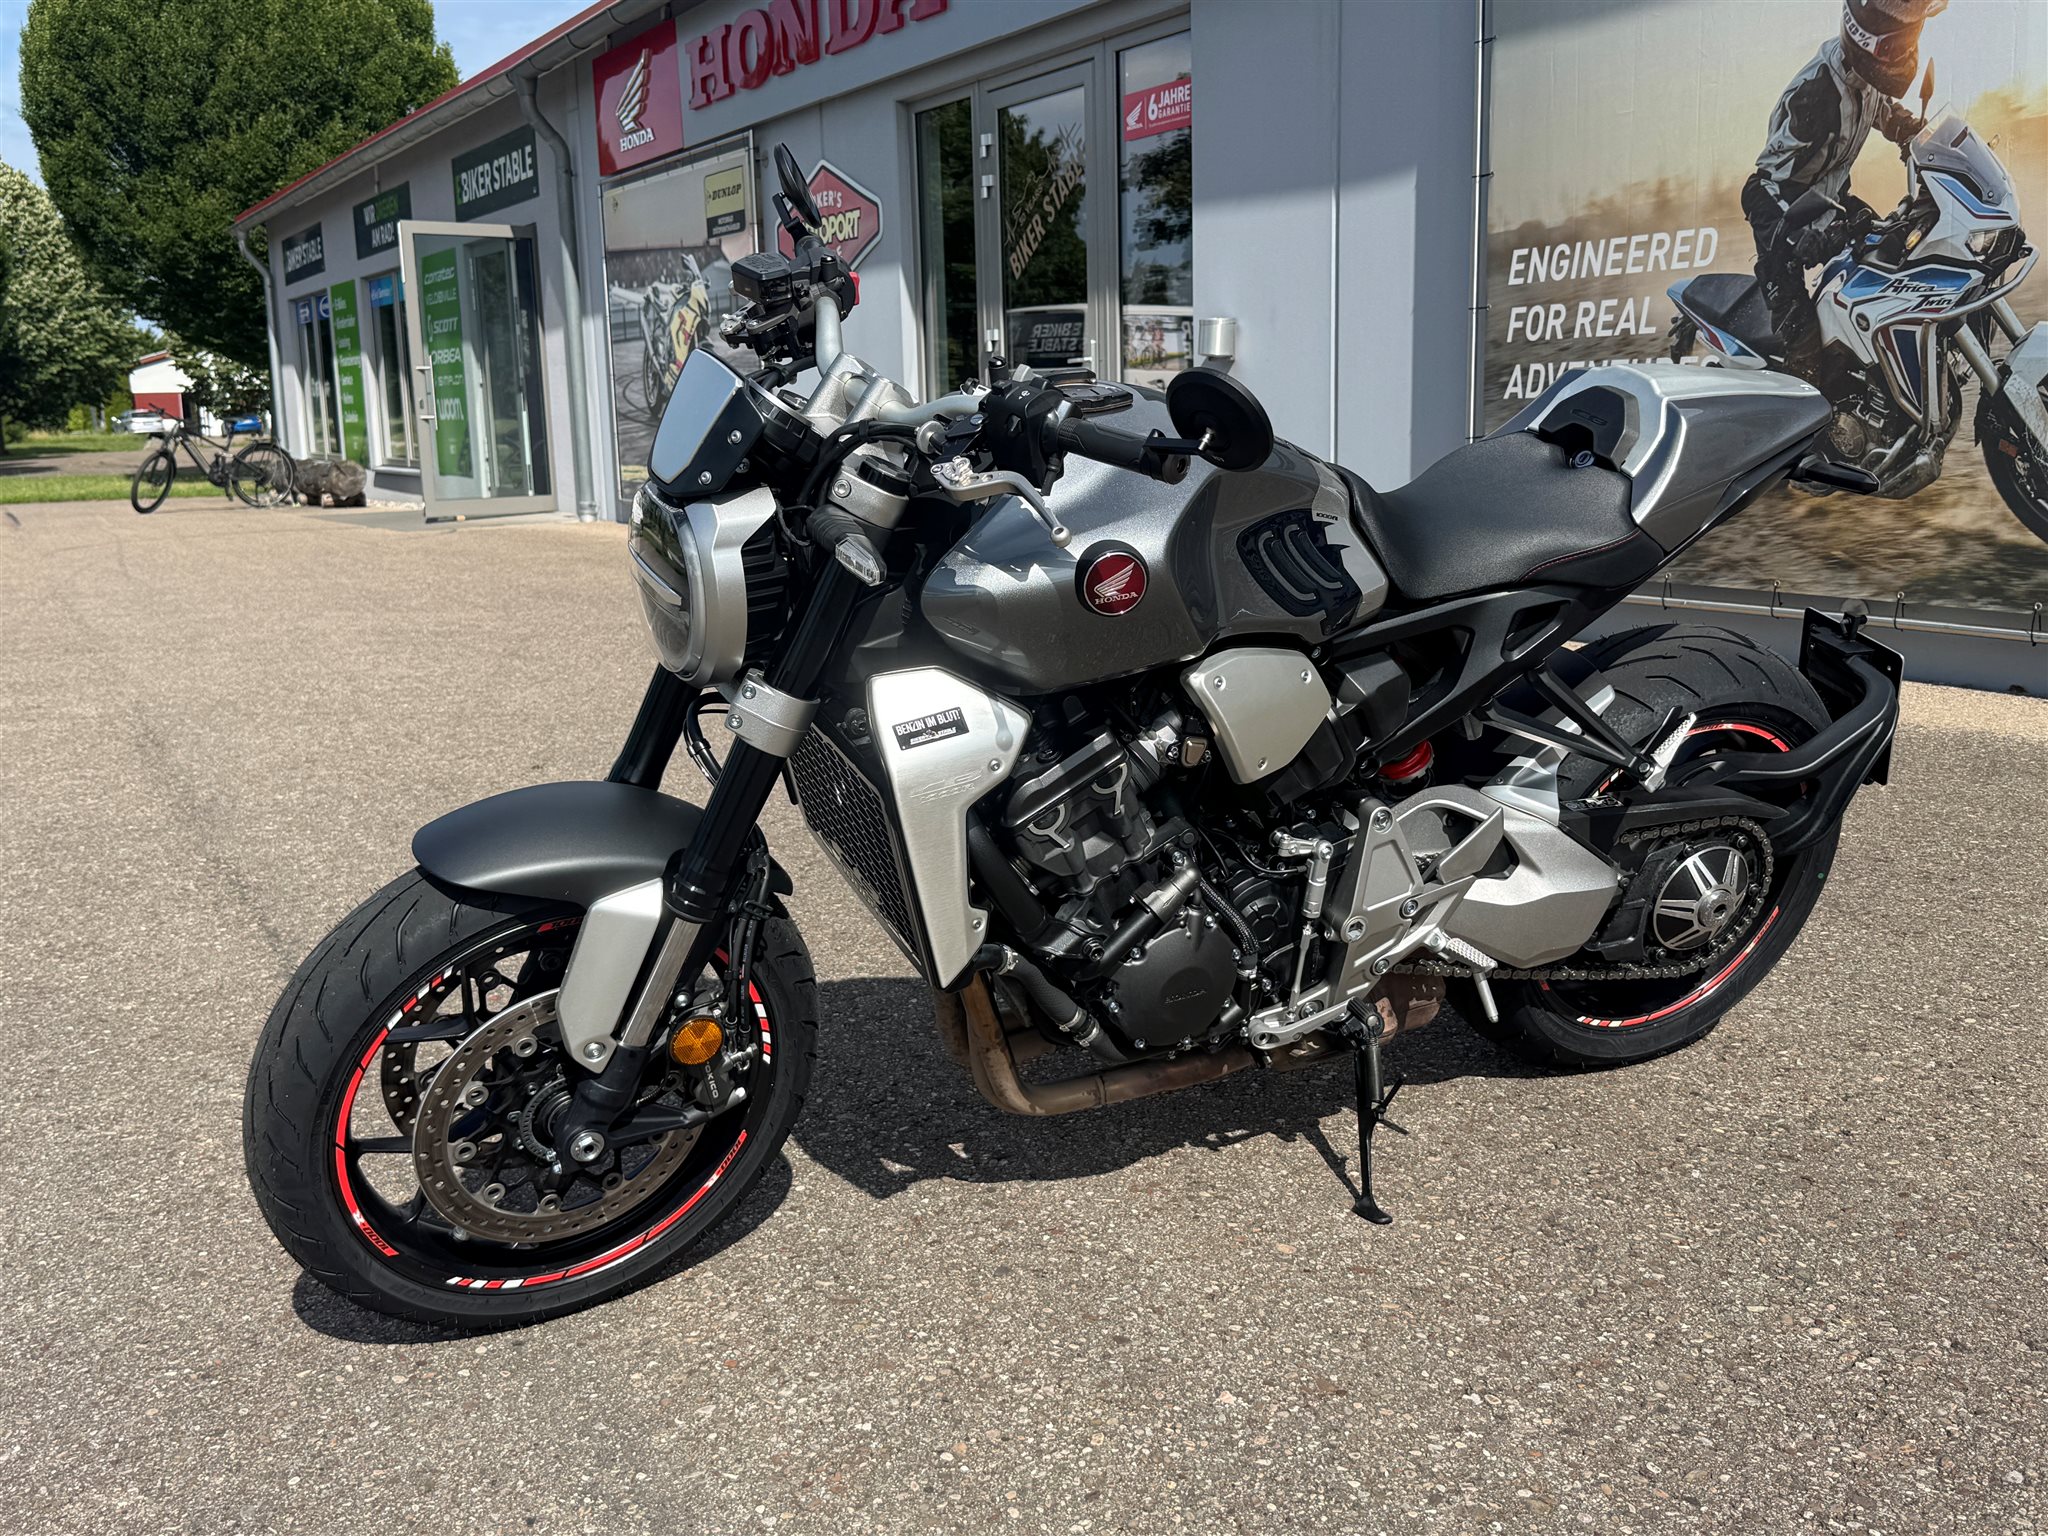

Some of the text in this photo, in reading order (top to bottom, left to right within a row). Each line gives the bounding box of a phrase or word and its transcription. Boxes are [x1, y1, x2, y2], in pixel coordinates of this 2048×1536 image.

[1148, 84, 1191, 121] 6 JAHRE
[1158, 102, 1191, 119] GARANTIE
[620, 127, 655, 153] HONDA
[492, 144, 534, 191] STABLE
[712, 183, 742, 201] DUNLOP
[813, 190, 842, 208] KER'S
[1009, 158, 1085, 281] BIKER STABL
[1507, 227, 1719, 287] ENGINEERED
[1878, 278, 1940, 296] Africa
[1908, 293, 1954, 312] Twin
[433, 317, 458, 334] SCOTT
[1506, 300, 1658, 344] FOR REAL
[431, 347, 462, 365] ORBEA
[1094, 591, 1139, 605] HONDA
[895, 719, 926, 736] BENZIN
[925, 715, 937, 728] IM
[936, 709, 960, 725] BLUT!
[704, 1060, 719, 1099] OKICO
